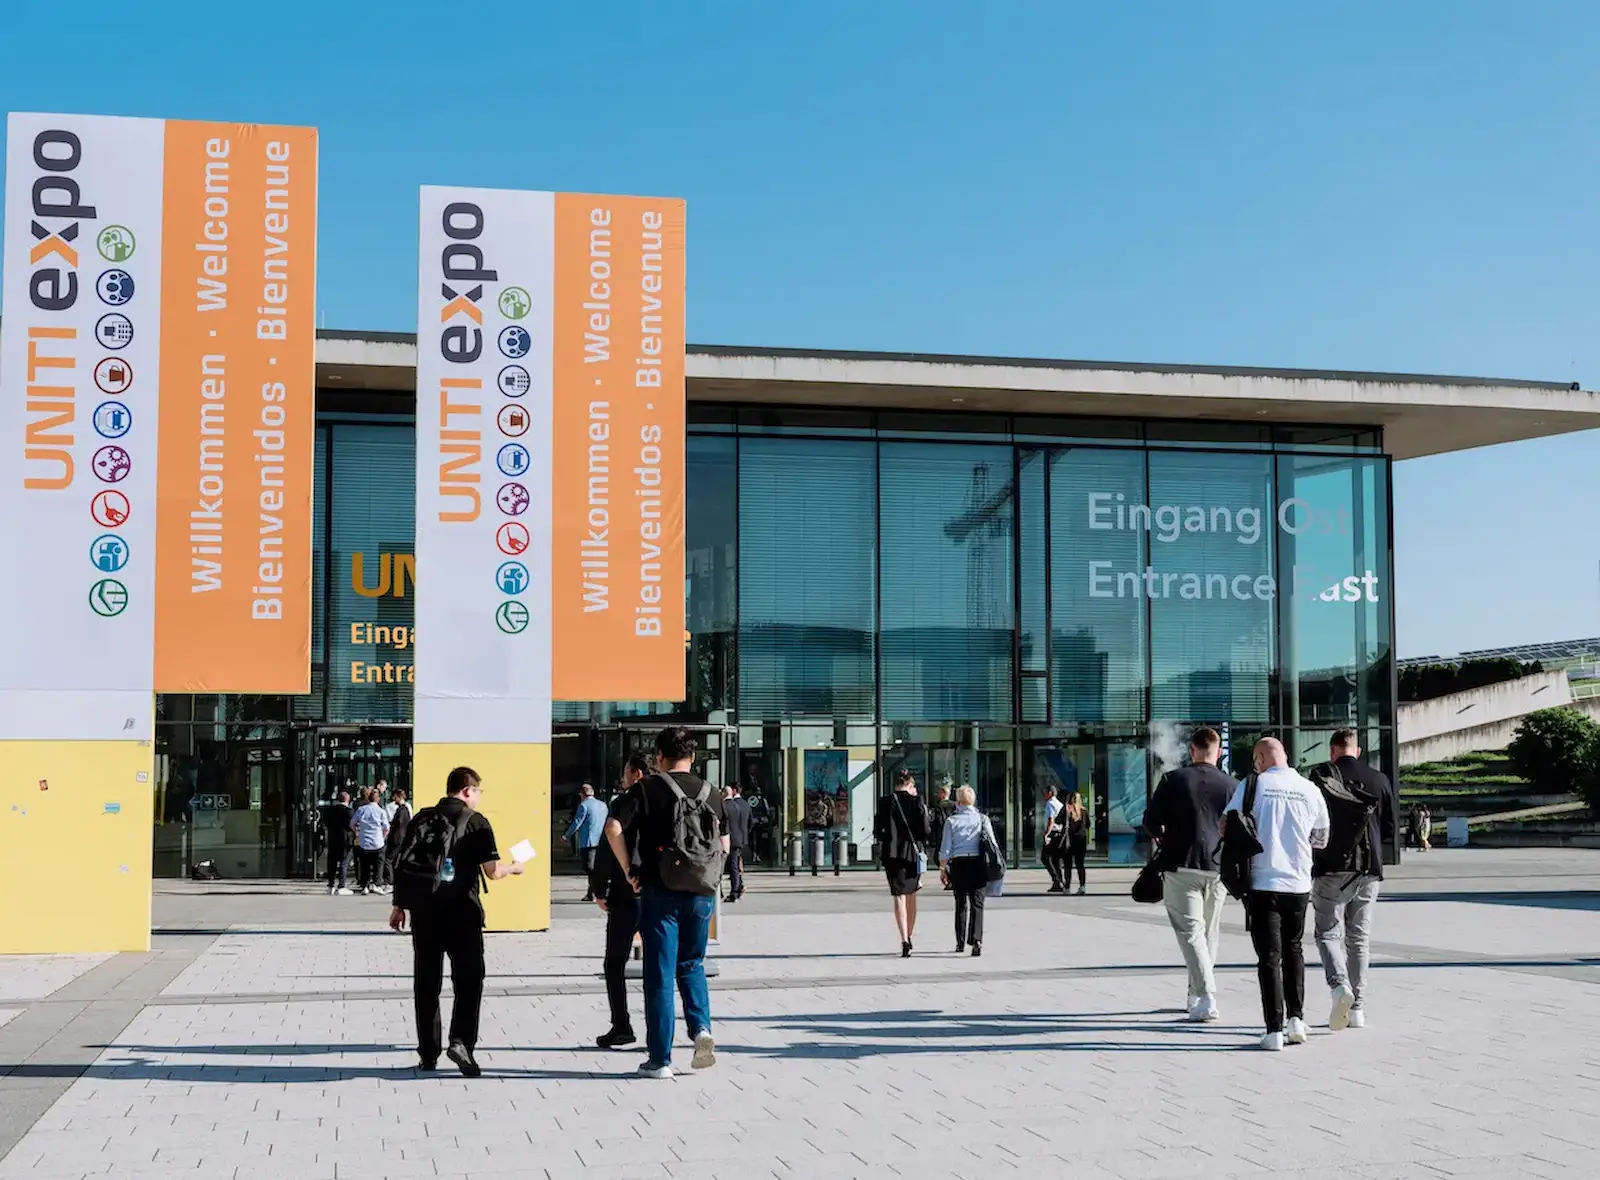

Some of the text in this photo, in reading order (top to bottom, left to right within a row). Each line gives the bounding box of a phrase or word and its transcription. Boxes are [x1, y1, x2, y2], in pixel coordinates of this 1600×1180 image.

[24, 129, 97, 490] UNITI expo
[190, 137, 231, 593] Willkommen Welcome
[252, 140, 290, 620] Bienvenidos Bienvenue
[438, 202, 498, 523] UNITI expo
[581, 207, 611, 613] Willkommen Welcome
[634, 210, 663, 637] Bienvenidos Bienvenue
[1088, 492, 1350, 545] Eingang Ost
[1088, 560, 1278, 601] Entrance
